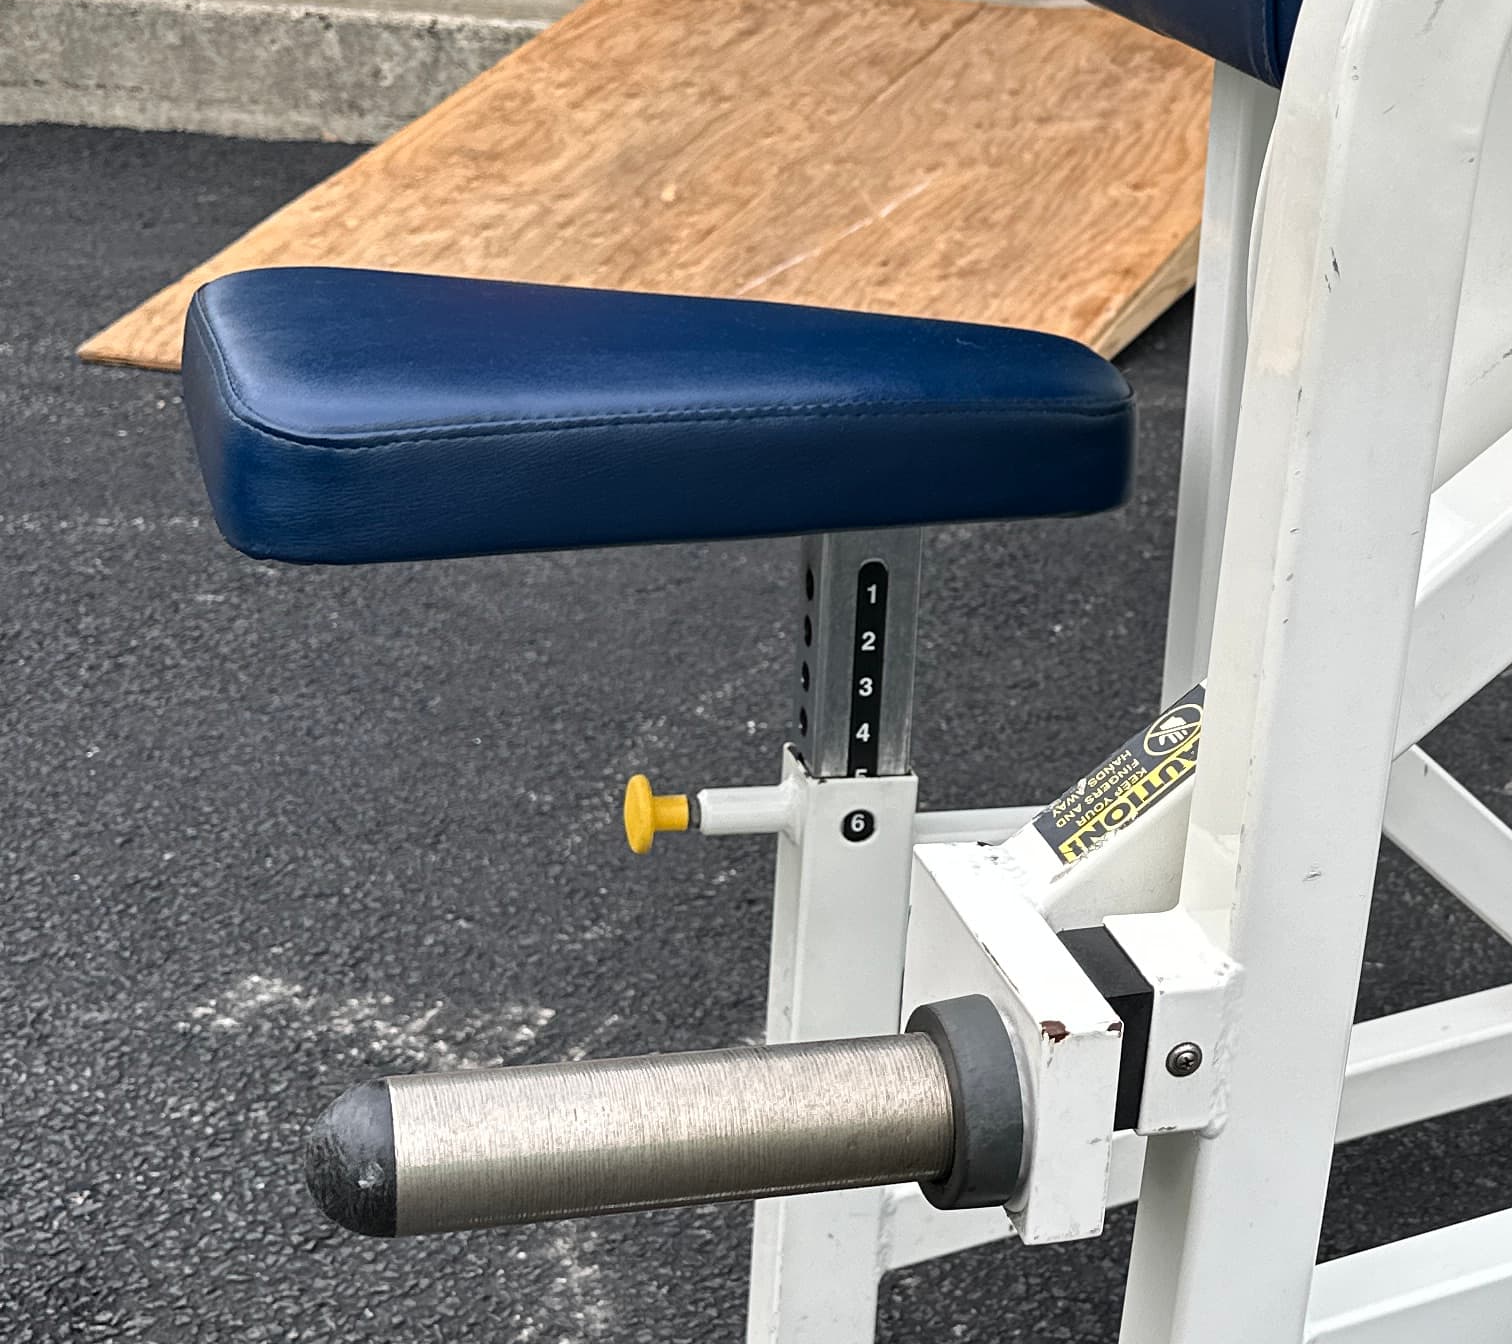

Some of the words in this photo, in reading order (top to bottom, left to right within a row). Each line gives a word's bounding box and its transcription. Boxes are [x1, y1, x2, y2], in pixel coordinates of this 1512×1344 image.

[866, 583, 878, 605] 1
[861, 631, 876, 652] 2
[858, 677, 873, 697] 3
[855, 722, 871, 743] 4
[1086, 759, 1140, 805] FINGERS
[1087, 749, 1132, 787] HANDS
[1113, 766, 1148, 797] KEEP
[1051, 786, 1086, 818] AWAY
[1065, 741, 1200, 859] AUTION!
[1076, 795, 1118, 826] YOUR
[850, 812, 866, 833] 6
[1055, 804, 1082, 829] AND
